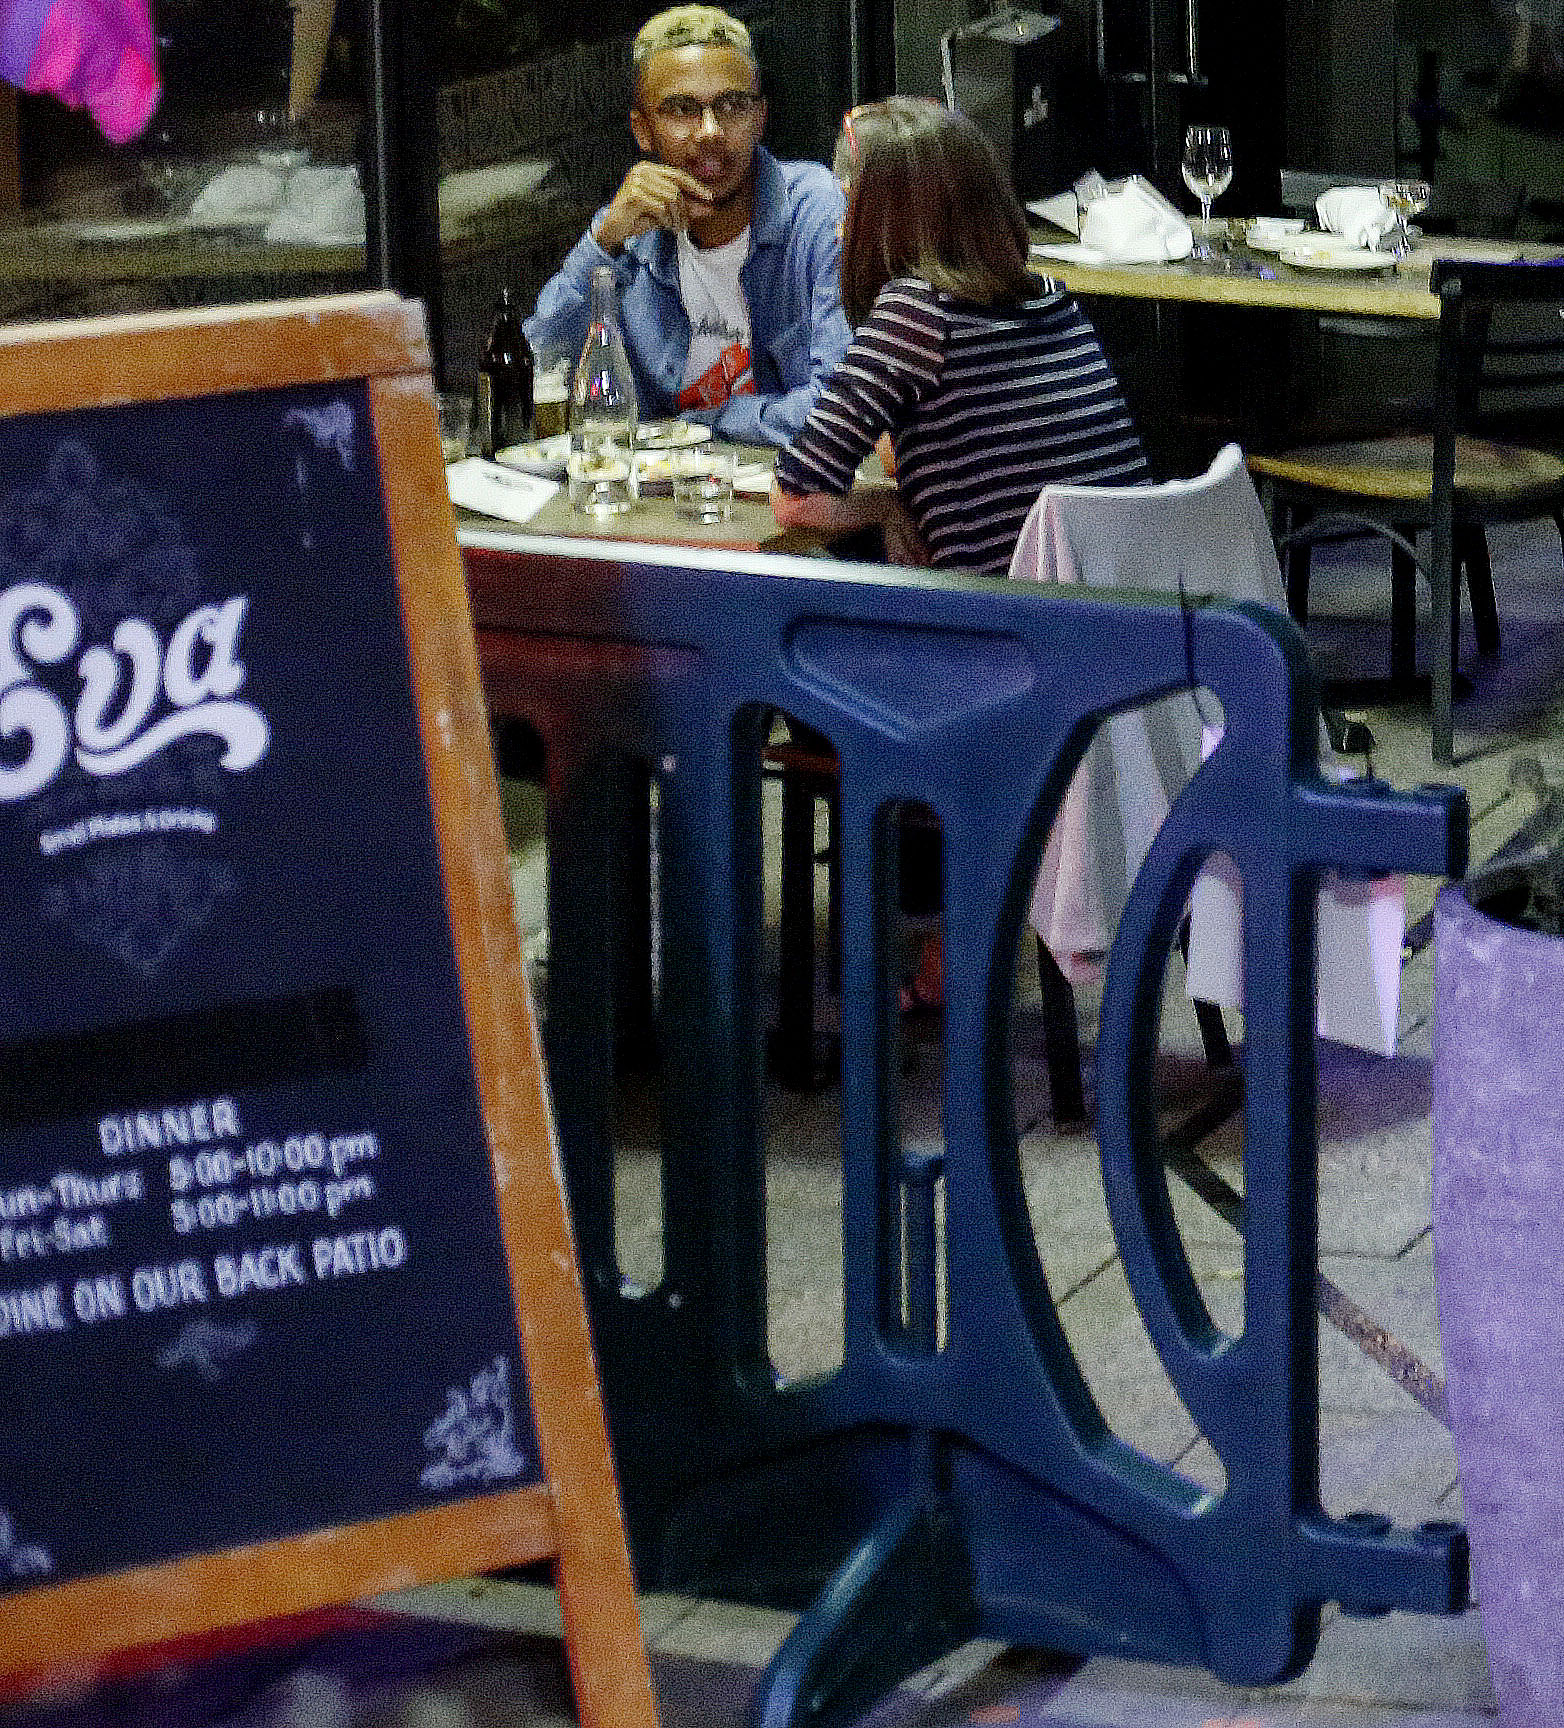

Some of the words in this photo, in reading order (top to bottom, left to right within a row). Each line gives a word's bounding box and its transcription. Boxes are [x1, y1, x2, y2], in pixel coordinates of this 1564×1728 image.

[100, 1096, 240, 1155] DINNER
[73, 1275, 126, 1323] ON
[132, 1258, 207, 1313] OUR
[214, 1244, 304, 1298] BACK
[312, 1225, 408, 1279] PATIO
